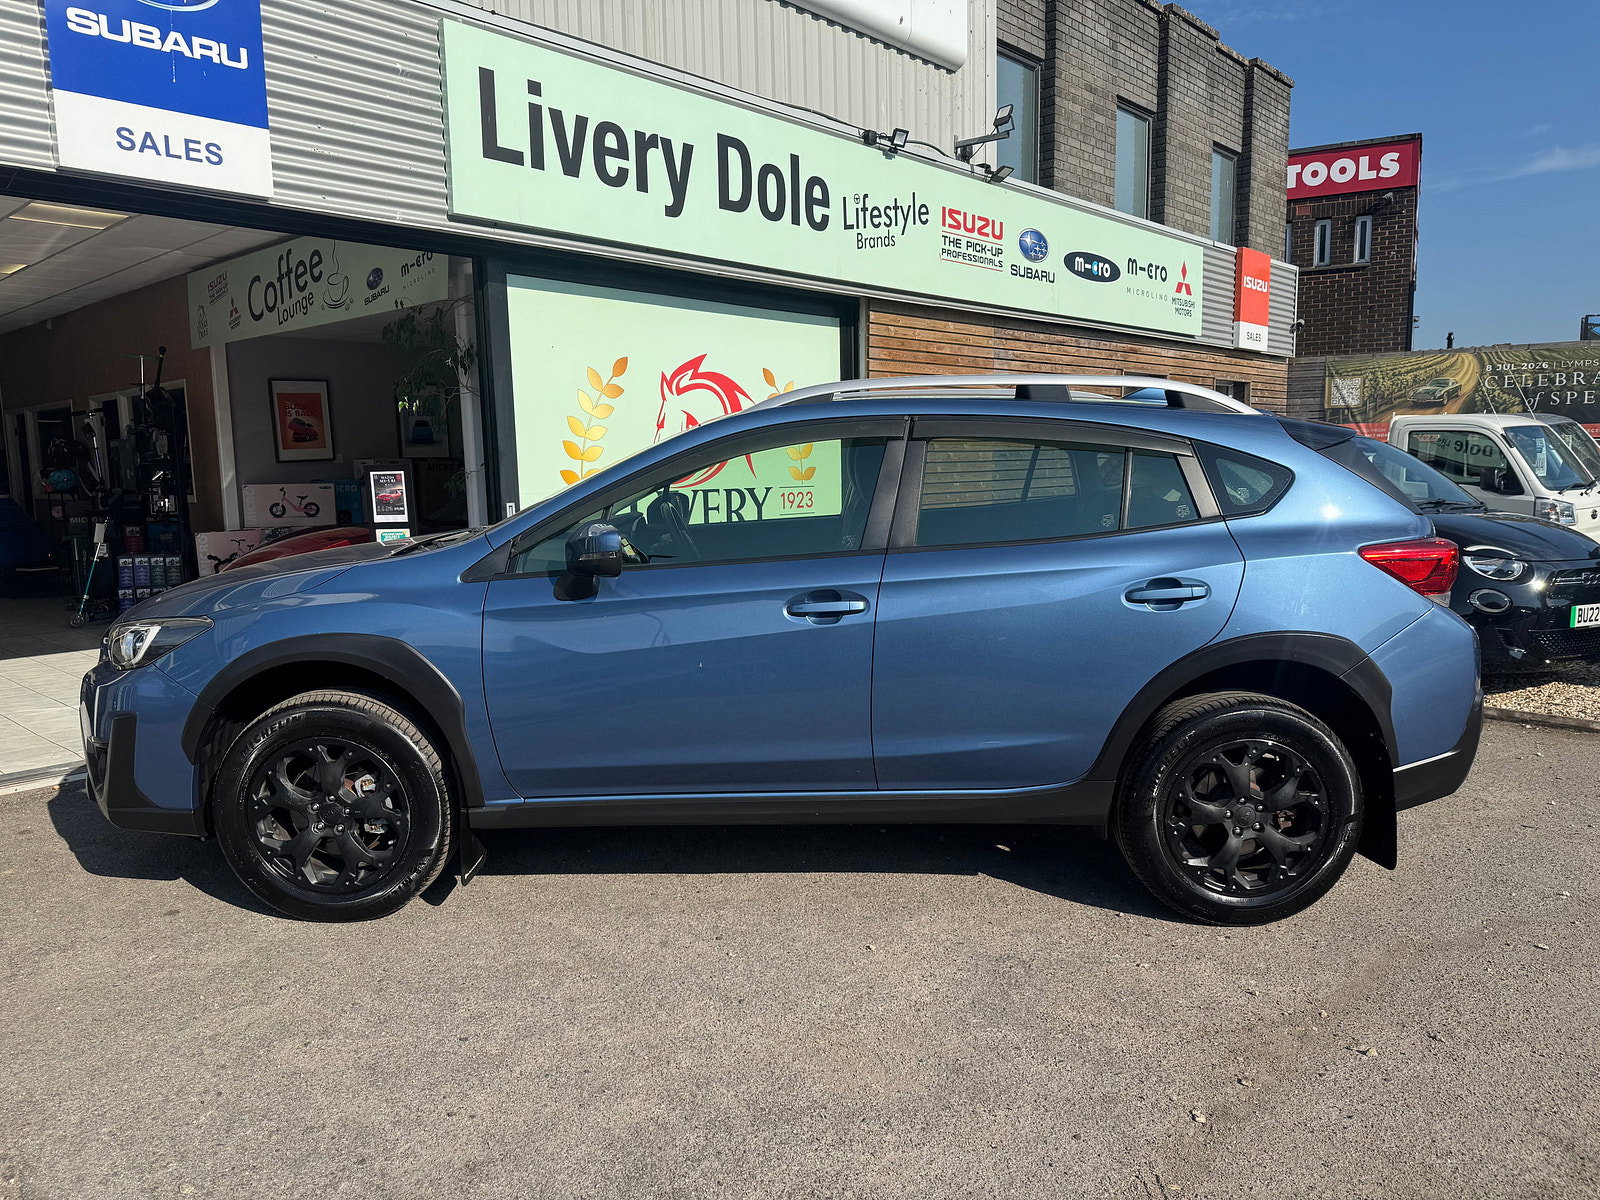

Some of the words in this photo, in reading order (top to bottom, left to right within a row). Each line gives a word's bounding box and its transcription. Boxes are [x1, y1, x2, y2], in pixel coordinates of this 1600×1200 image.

[66, 7, 249, 70] SUBARU
[116, 127, 224, 166] SALES
[478, 66, 694, 218] Livery
[717, 132, 830, 231] Dole
[1287, 152, 1400, 189] TOOLS
[843, 192, 929, 235] Lifestyle
[941, 206, 1004, 241] ISUZU
[856, 229, 896, 250] Brands
[941, 235, 962, 249] THE
[966, 240, 1004, 258] PICK-UP
[941, 248, 1004, 268] PROFESSIONALS
[206, 270, 228, 292] ISUZU
[247, 248, 323, 322] Coffee
[1010, 264, 1055, 284] SUBARU
[1243, 275, 1268, 293] ISUZU
[364, 284, 390, 306] SUBARU
[1126, 287, 1169, 302] MICROLINO
[1171, 296, 1196, 308] MITSUBISHI
[277, 291, 315, 326] Lounge
[1174, 306, 1193, 318] MOTORS
[1246, 331, 1262, 343] SALES
[1496, 363, 1517, 371] JUL
[1521, 362, 1549, 370] 2026
[1561, 358, 1600, 368] LYMPS
[1525, 391, 1545, 412] of
[1550, 390, 1595, 406] SPE
[780, 491, 814, 510] 1923
[1577, 606, 1600, 624] BU22
